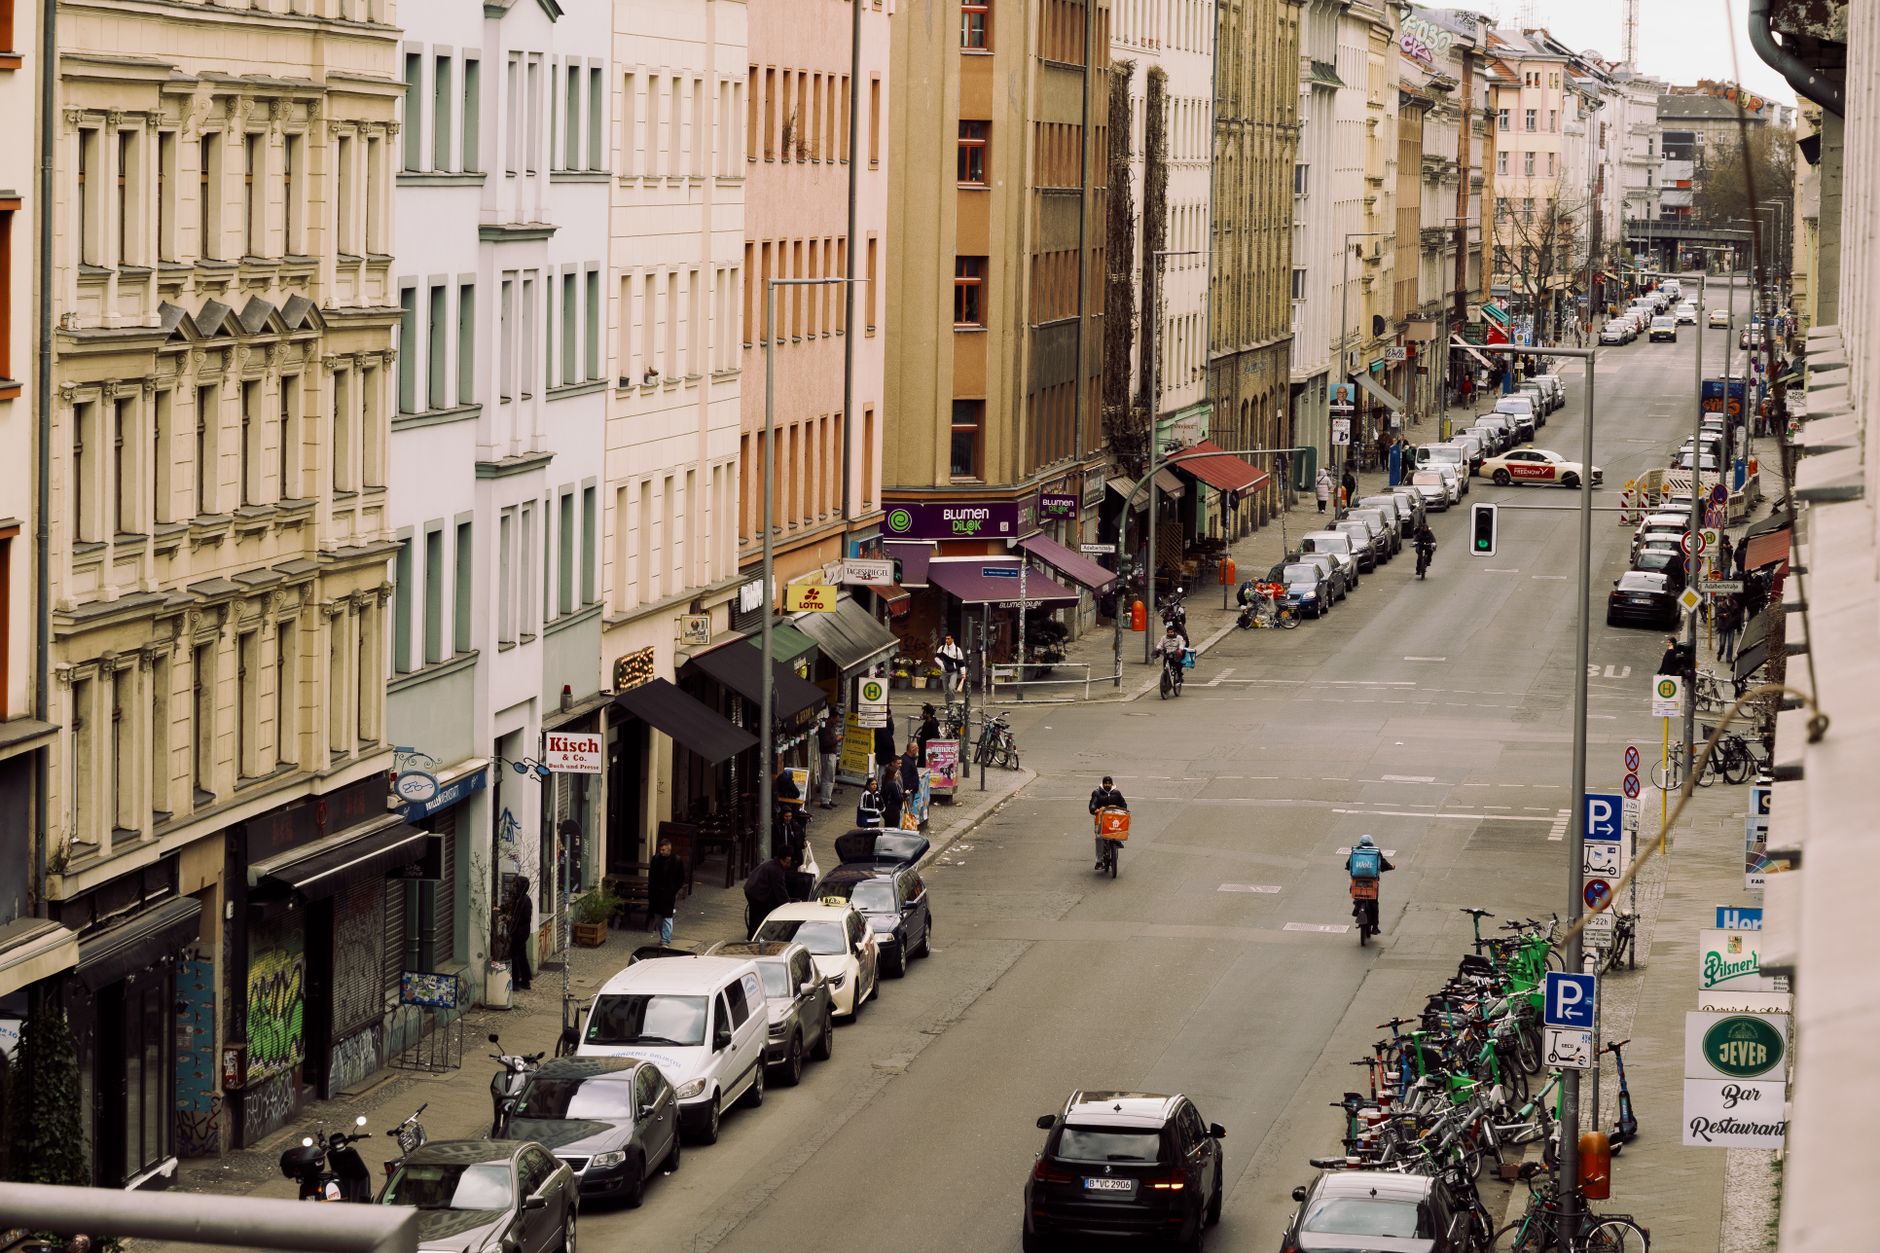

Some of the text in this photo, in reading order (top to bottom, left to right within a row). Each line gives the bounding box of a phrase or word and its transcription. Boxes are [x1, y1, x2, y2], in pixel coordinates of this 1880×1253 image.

[846, 567, 889, 577] TAGESSPIEGEL
[799, 602, 824, 610] LOTTO
[549, 737, 599, 753] Kisch
[573, 754, 587, 762] Co.
[1588, 799, 1613, 835] P
[1704, 951, 1753, 988] Pilsner
[1556, 979, 1583, 1019] P
[1719, 1041, 1767, 1067] JEVER
[1721, 1084, 1762, 1109] Bar
[1690, 1116, 1785, 1143] Restaurant
[1090, 1179, 1095, 1188] B
[1110, 1180, 1131, 1189] 2906
